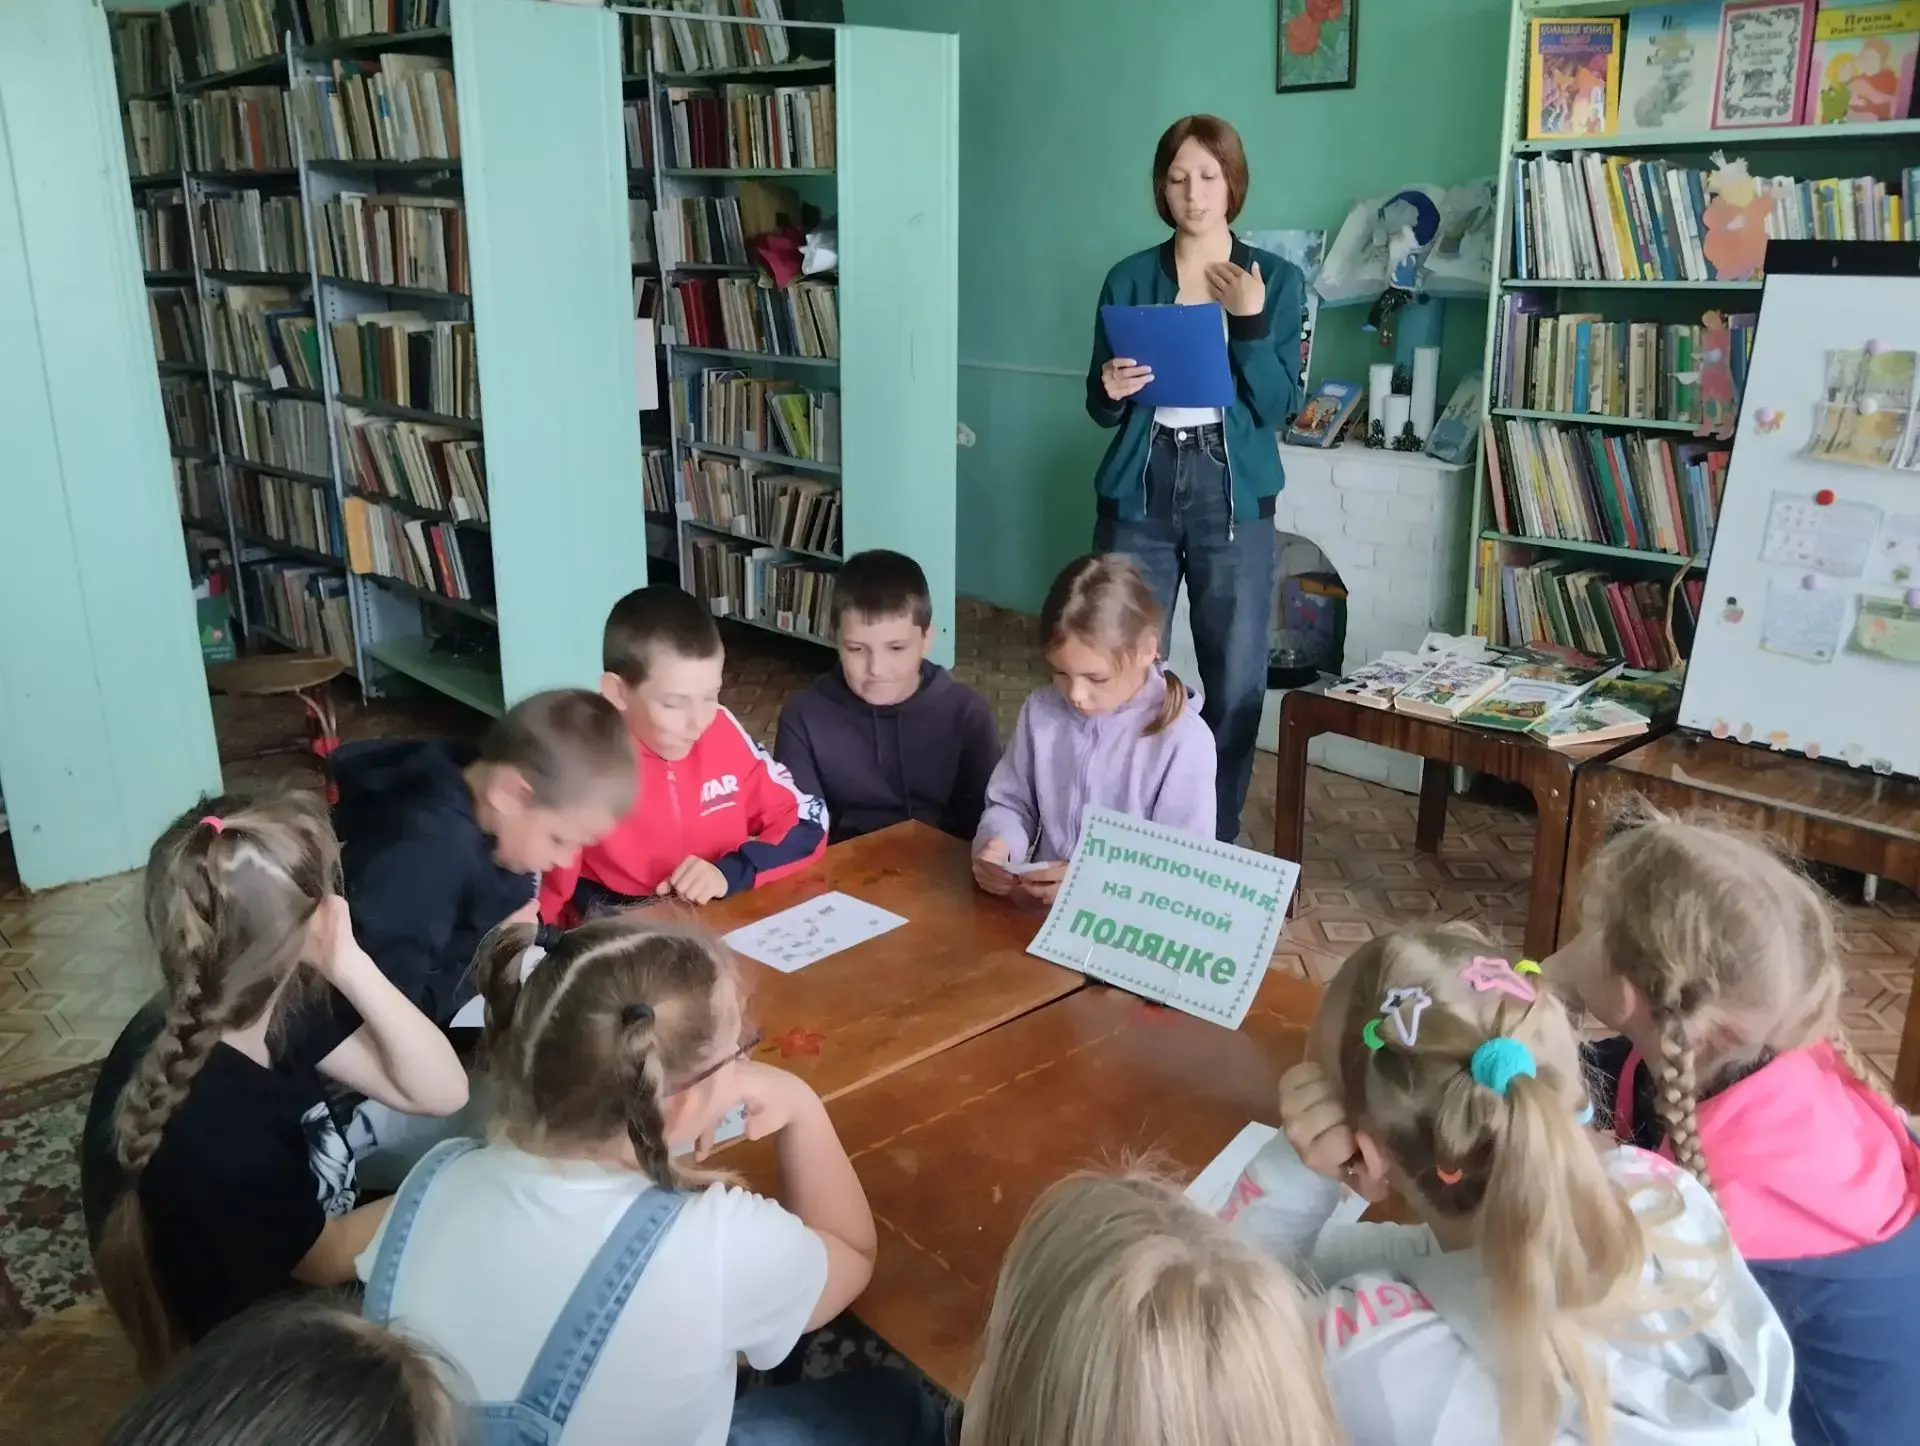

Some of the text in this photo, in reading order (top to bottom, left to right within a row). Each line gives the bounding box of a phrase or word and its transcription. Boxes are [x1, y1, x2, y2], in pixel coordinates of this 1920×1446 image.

[1088, 838, 1273, 910] Приключения
[1101, 880, 1233, 934] на лесной
[1069, 908, 1237, 985] полянке
